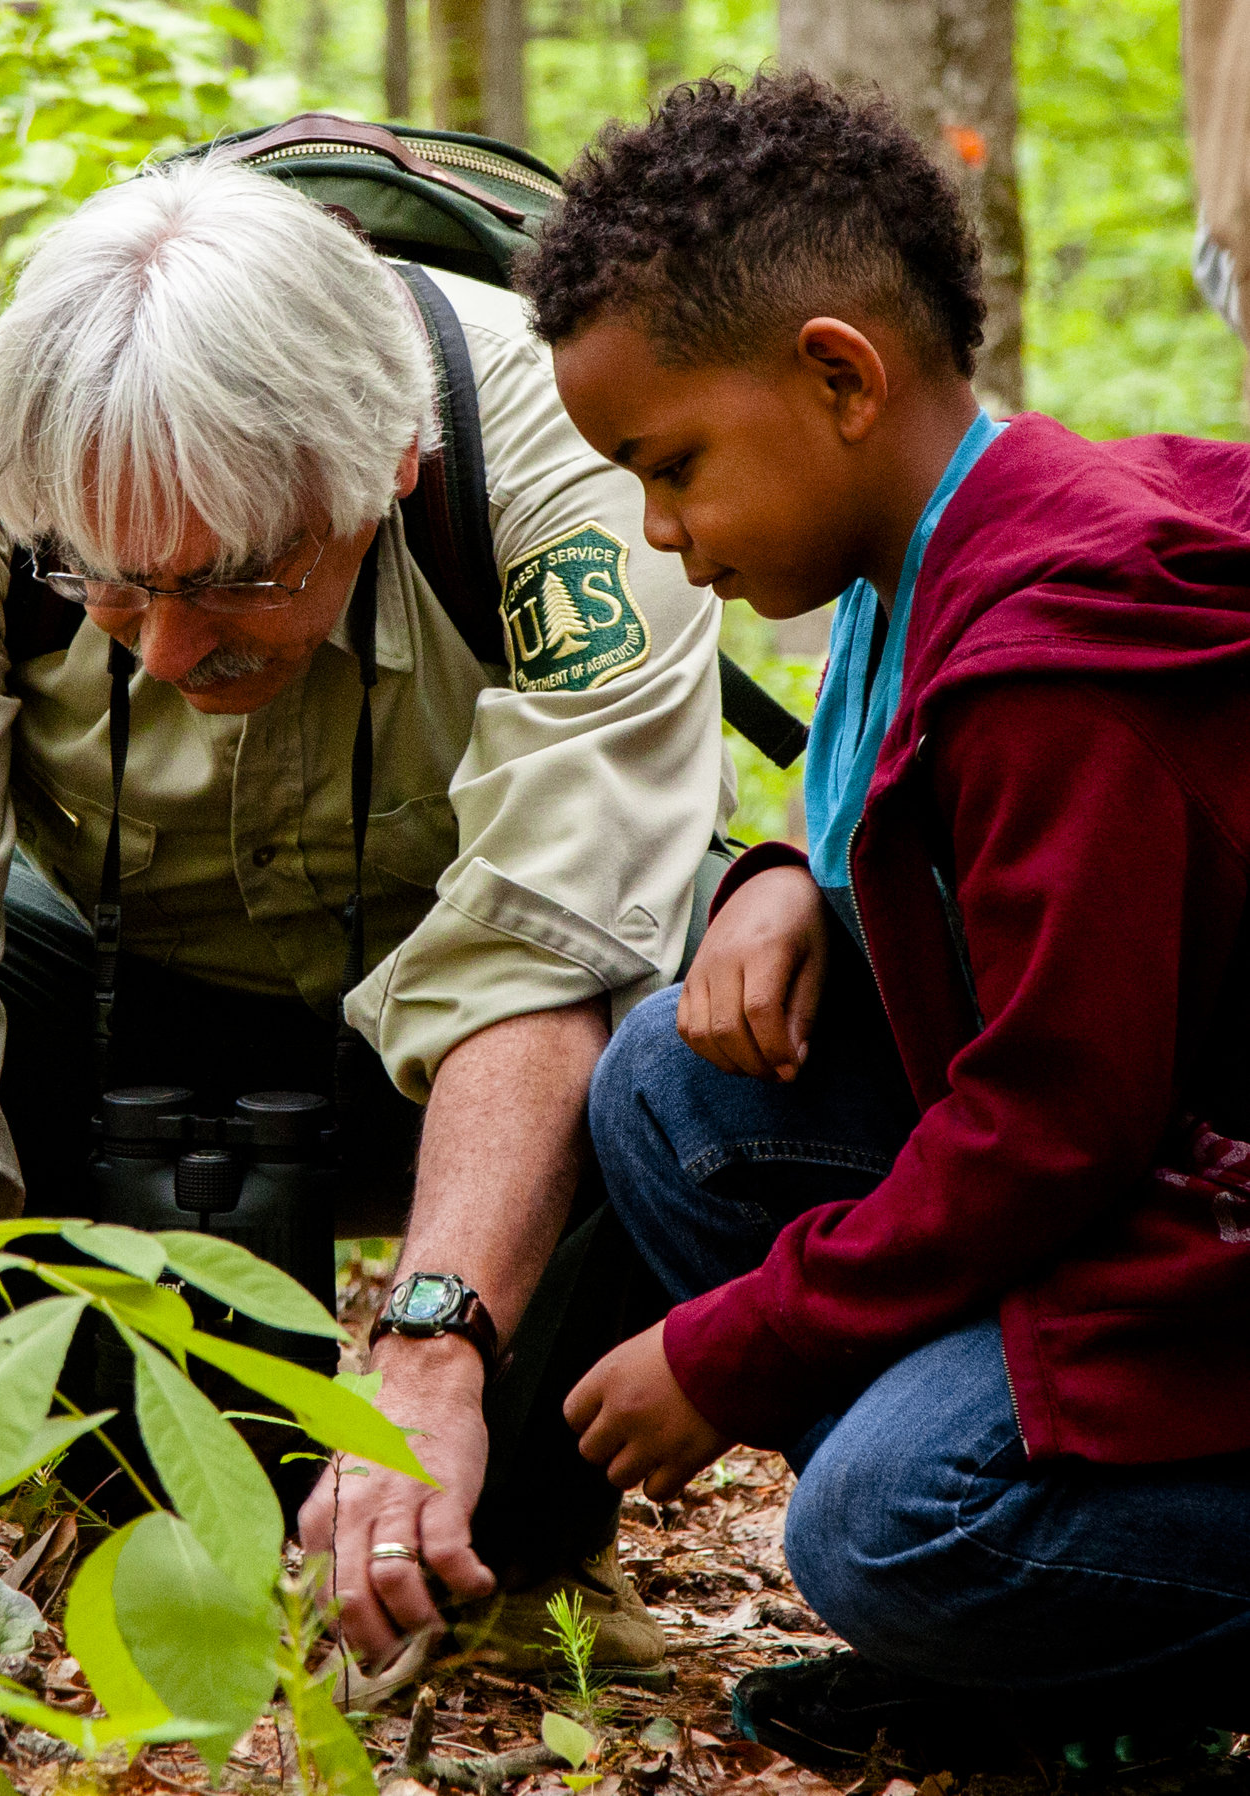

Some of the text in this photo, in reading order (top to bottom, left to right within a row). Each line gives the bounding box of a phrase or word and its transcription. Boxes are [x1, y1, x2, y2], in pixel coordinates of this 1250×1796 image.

[548, 546, 617, 566] SERVICE
[508, 570, 623, 662] U S
[571, 663, 585, 680] OF
[587, 622, 642, 674] AGRICULTURE
